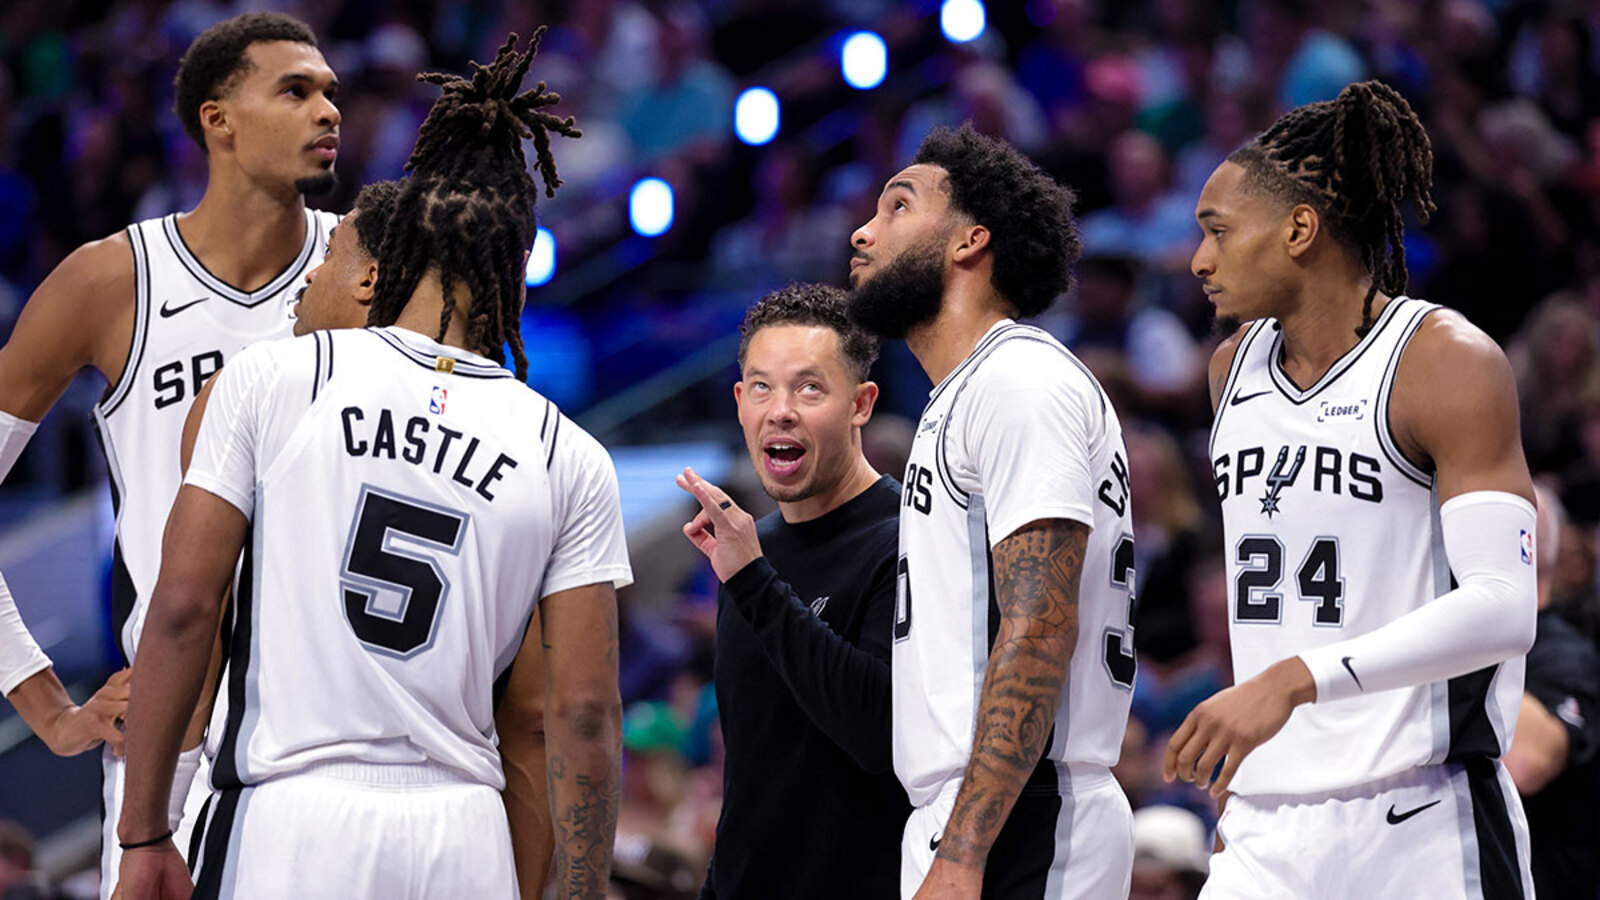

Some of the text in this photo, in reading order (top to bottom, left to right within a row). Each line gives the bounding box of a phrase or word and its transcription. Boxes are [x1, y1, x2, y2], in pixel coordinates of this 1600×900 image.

[153, 350, 223, 410] SP
[341, 406, 518, 502] CASTLE
[903, 463, 933, 516] RS
[1098, 450, 1130, 518] CH
[1213, 445, 1383, 520] SPURS
[339, 482, 471, 662] 5
[1233, 533, 1346, 628] 24
